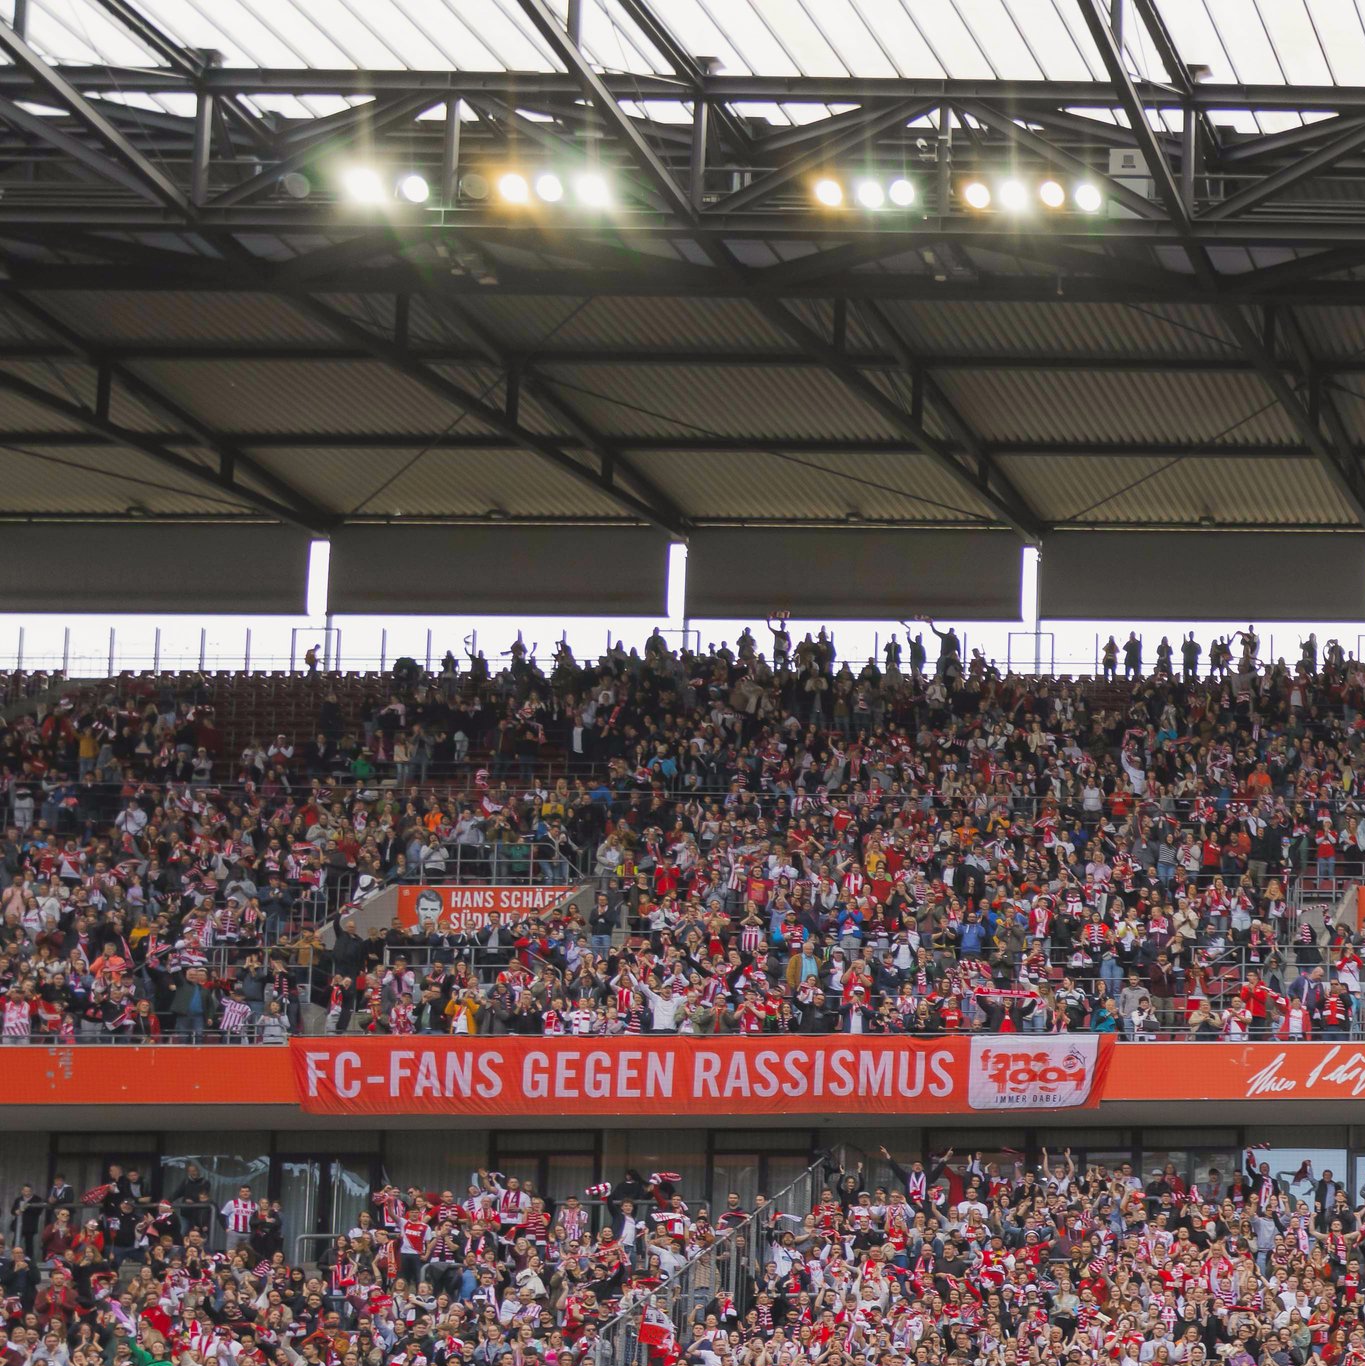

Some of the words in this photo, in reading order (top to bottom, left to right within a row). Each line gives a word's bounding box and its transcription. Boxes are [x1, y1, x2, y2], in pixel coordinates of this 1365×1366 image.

[451, 890, 495, 908] HANS
[980, 1049, 1051, 1071] fans
[305, 1050, 504, 1098] FC-FANS
[522, 1051, 675, 1098] GEGEN
[693, 1050, 954, 1098] RASSISMUS
[995, 1095, 1027, 1103] IMMER
